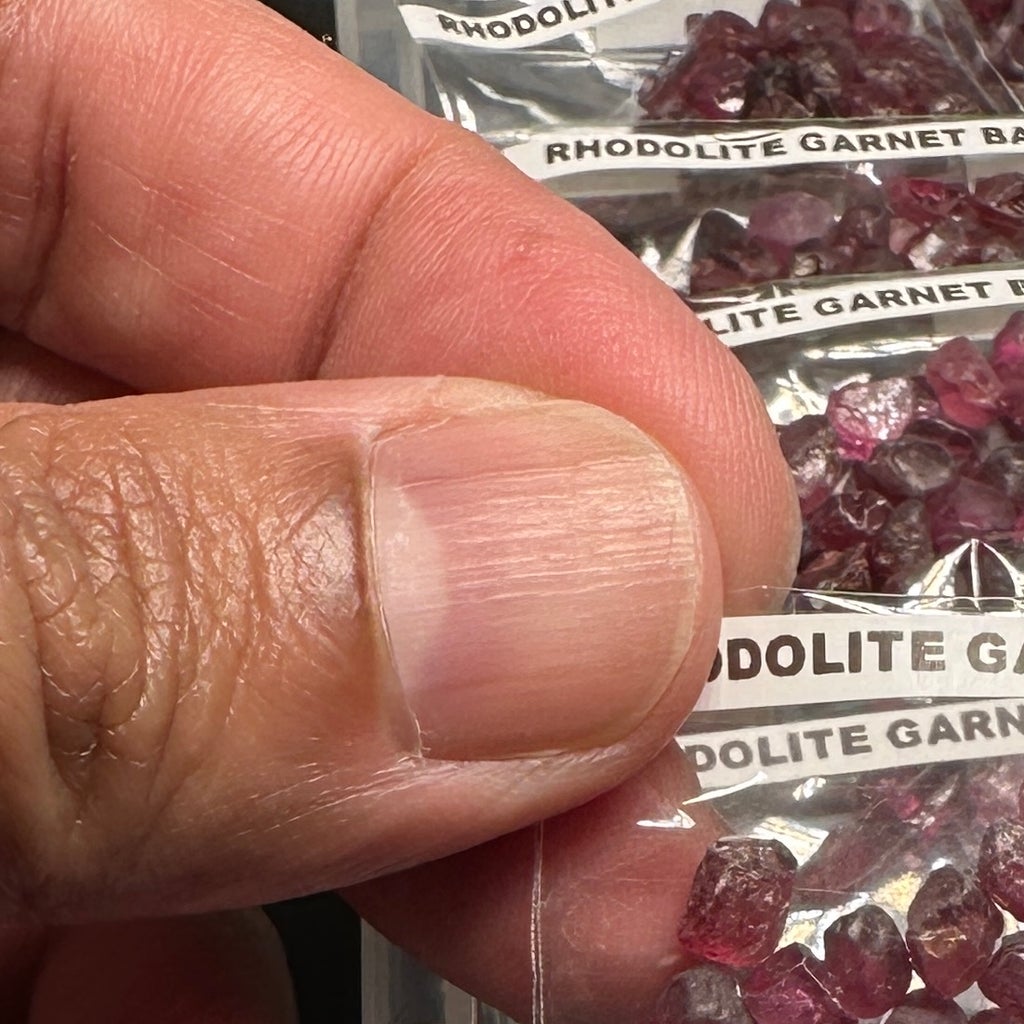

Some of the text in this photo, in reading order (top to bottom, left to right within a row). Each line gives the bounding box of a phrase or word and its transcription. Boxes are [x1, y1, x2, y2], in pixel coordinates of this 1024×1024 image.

[436, 0, 632, 39] RHODOLI
[546, 138, 787, 164] RHODOLITE
[800, 128, 965, 152] GARNET
[813, 281, 993, 316] GARNET
[708, 631, 945, 682] DOLITE
